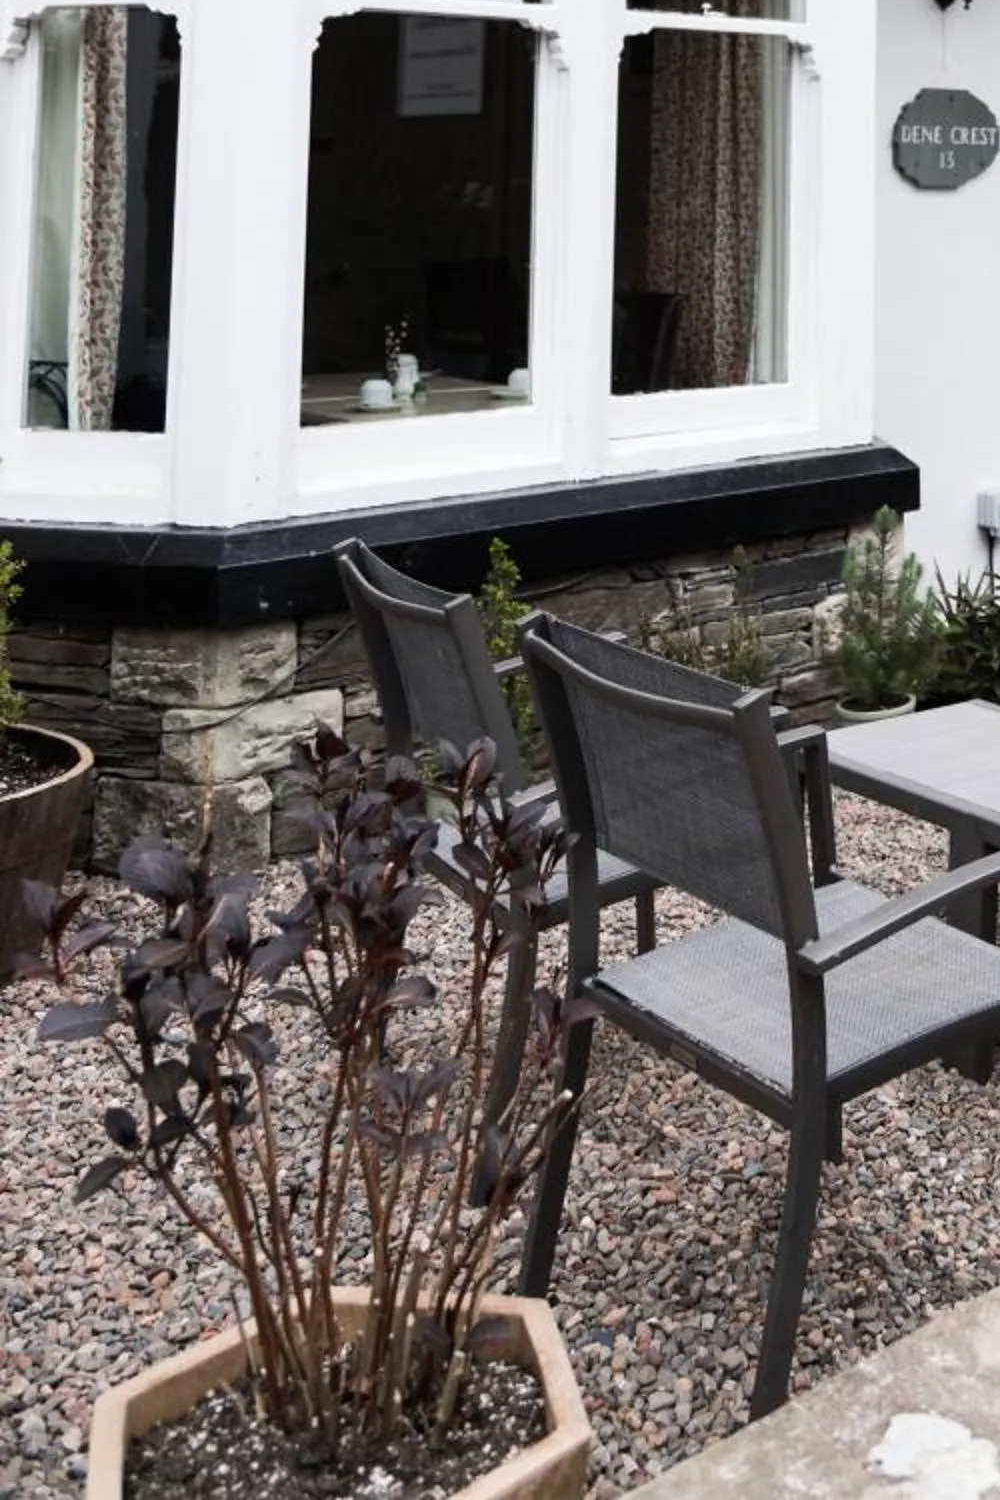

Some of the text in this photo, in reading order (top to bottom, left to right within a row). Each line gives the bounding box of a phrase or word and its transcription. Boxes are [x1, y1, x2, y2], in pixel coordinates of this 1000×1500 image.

[901, 124, 998, 146] DENE CREST
[938, 151, 956, 169] 13
